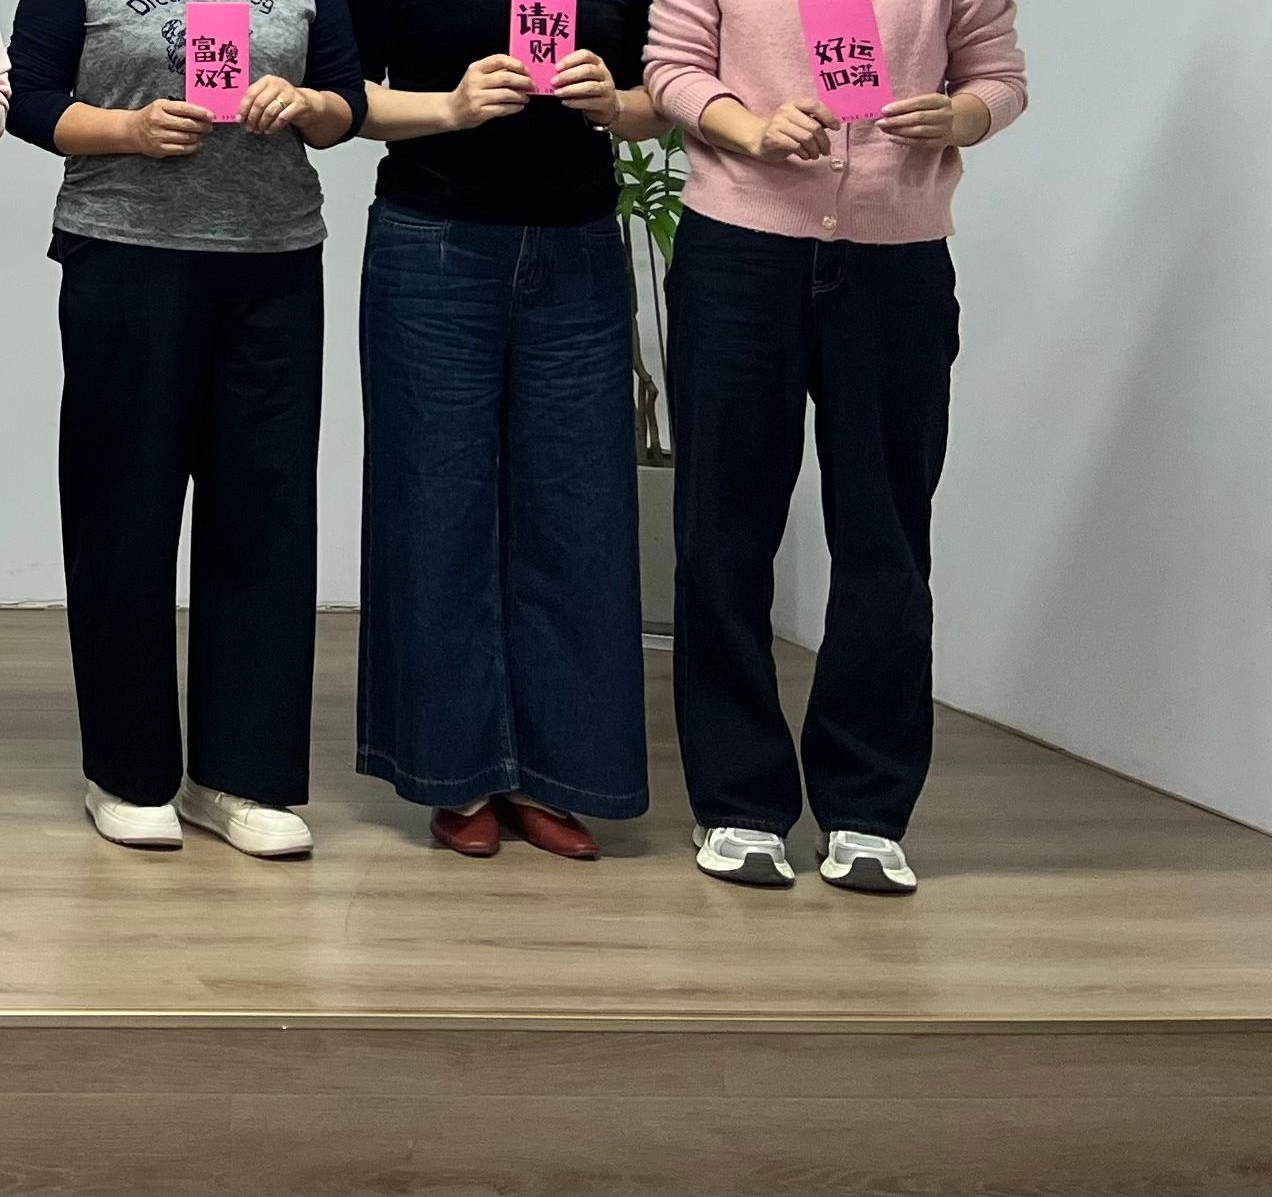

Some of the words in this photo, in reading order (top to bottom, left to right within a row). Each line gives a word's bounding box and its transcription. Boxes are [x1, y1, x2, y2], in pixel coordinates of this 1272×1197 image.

[517, 2, 570, 39] 请发
[529, 37, 558, 64] 财
[814, 37, 875, 65] 好运
[194, 63, 242, 90] 双全
[819, 64, 880, 92] 加满
